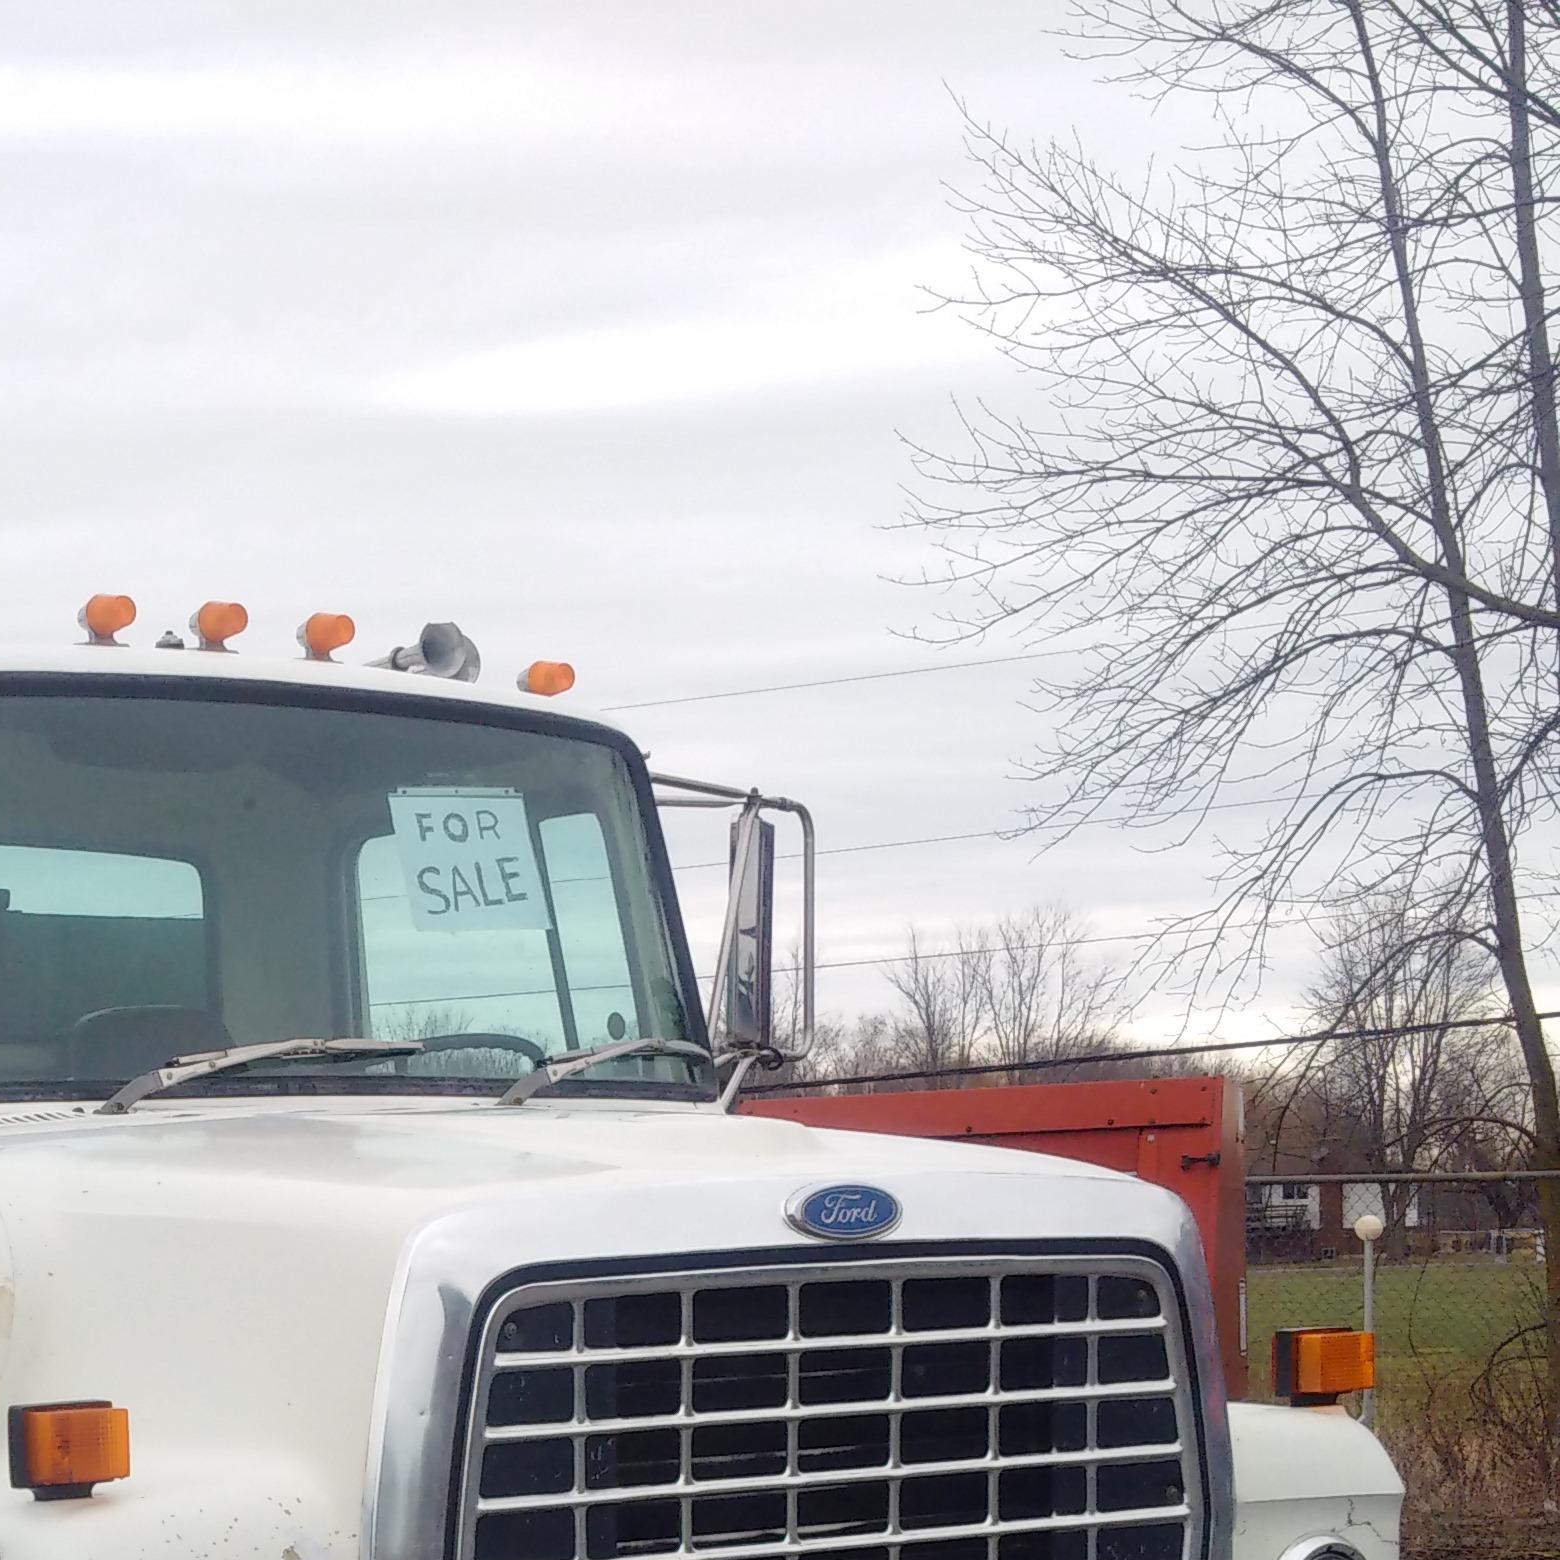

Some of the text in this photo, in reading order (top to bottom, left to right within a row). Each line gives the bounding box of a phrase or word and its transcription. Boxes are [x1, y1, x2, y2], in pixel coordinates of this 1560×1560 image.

[414, 809, 501, 843] FOR
[416, 856, 529, 915] SALE
[820, 1192, 878, 1224] Ford
